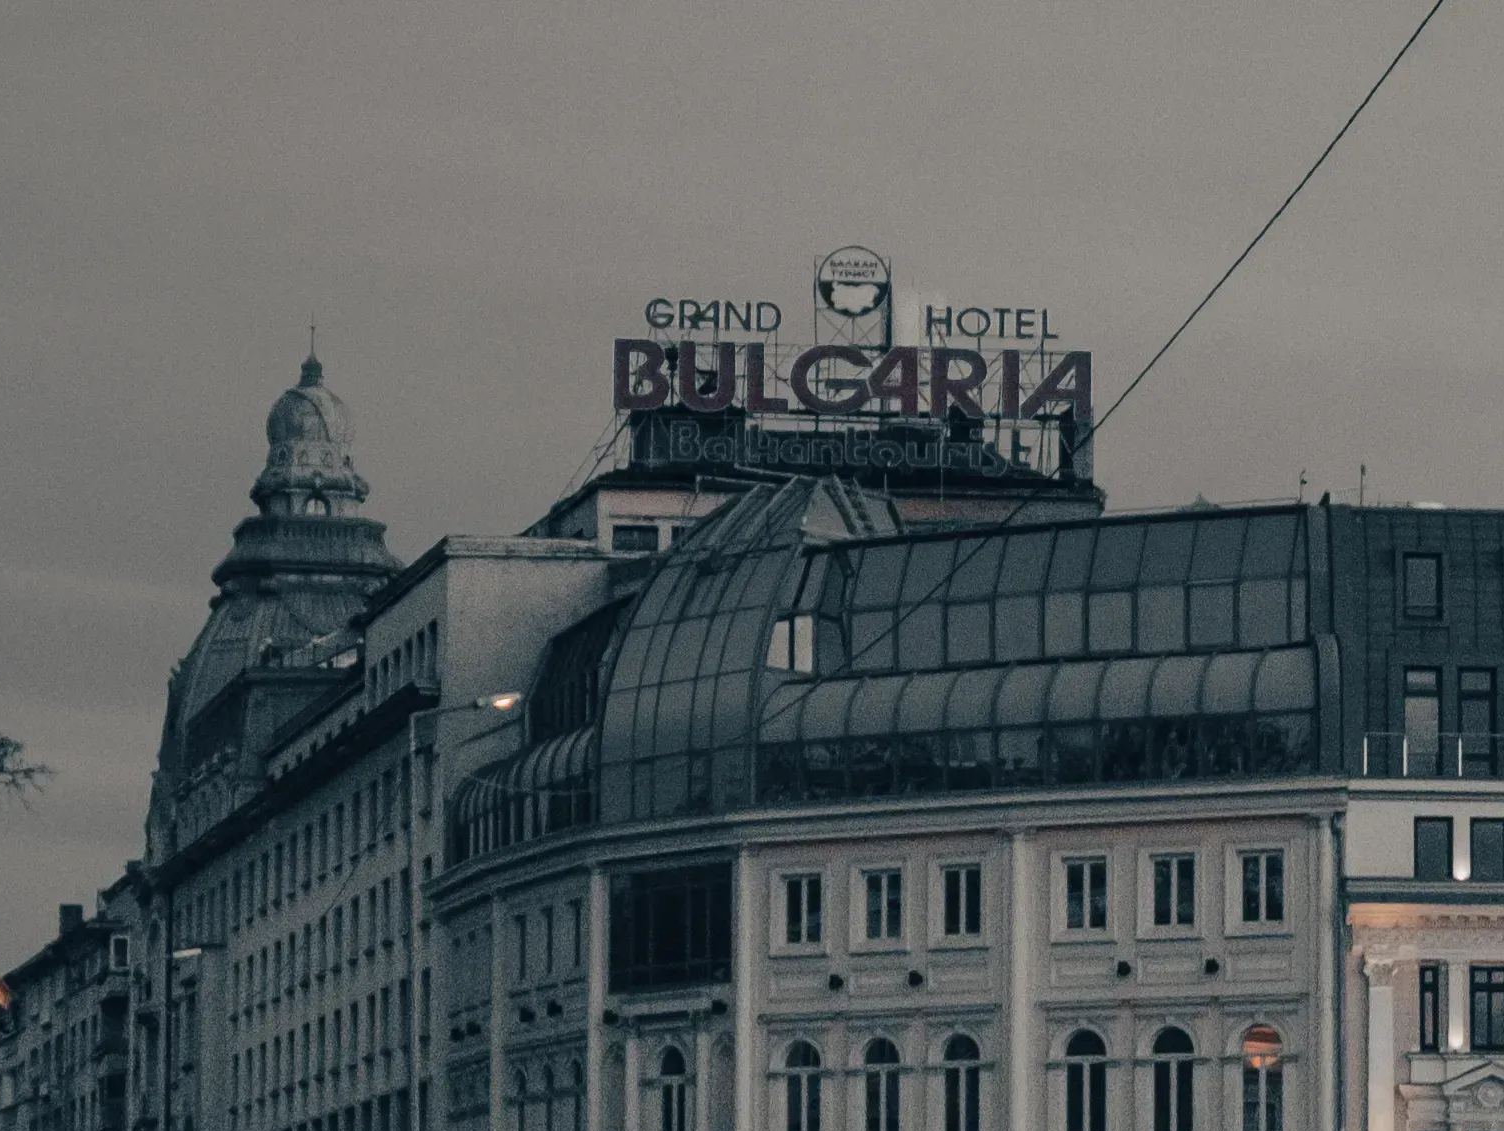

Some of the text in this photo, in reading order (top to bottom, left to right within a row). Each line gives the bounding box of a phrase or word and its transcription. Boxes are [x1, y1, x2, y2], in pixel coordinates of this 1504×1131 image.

[645, 298, 1060, 340] GRAND HOTEL
[613, 338, 1094, 420] BULGARIA
